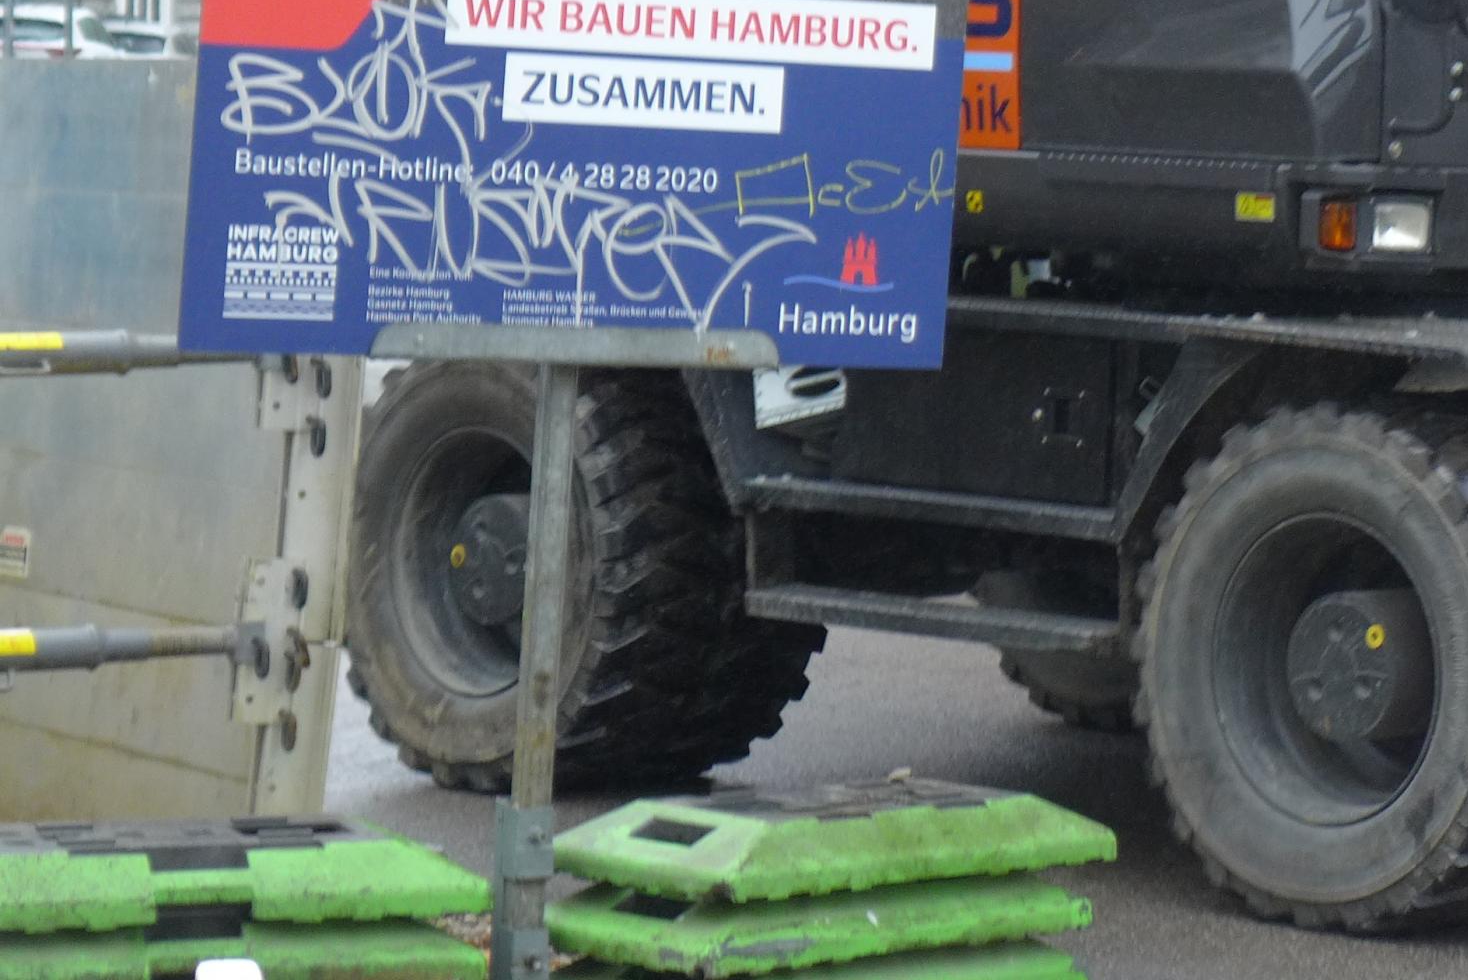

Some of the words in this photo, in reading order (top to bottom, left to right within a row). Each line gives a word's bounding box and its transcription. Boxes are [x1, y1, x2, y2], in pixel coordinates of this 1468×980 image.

[559, 0, 697, 40] BAUEN
[710, 10, 919, 54] HAMBURG.
[521, 70, 766, 116] ZUSAMMEN.
[491, 159, 539, 186] 040
[584, 162, 615, 189] 28
[619, 164, 651, 190] 28
[655, 165, 718, 193] 2020
[228, 223, 340, 245] INFRACREW
[226, 241, 339, 264] HAMBURG
[406, 286, 450, 301] Hamburg
[503, 289, 553, 302] HAMBURG
[409, 299, 453, 314] Hamburg
[778, 302, 918, 344] Hamburg
